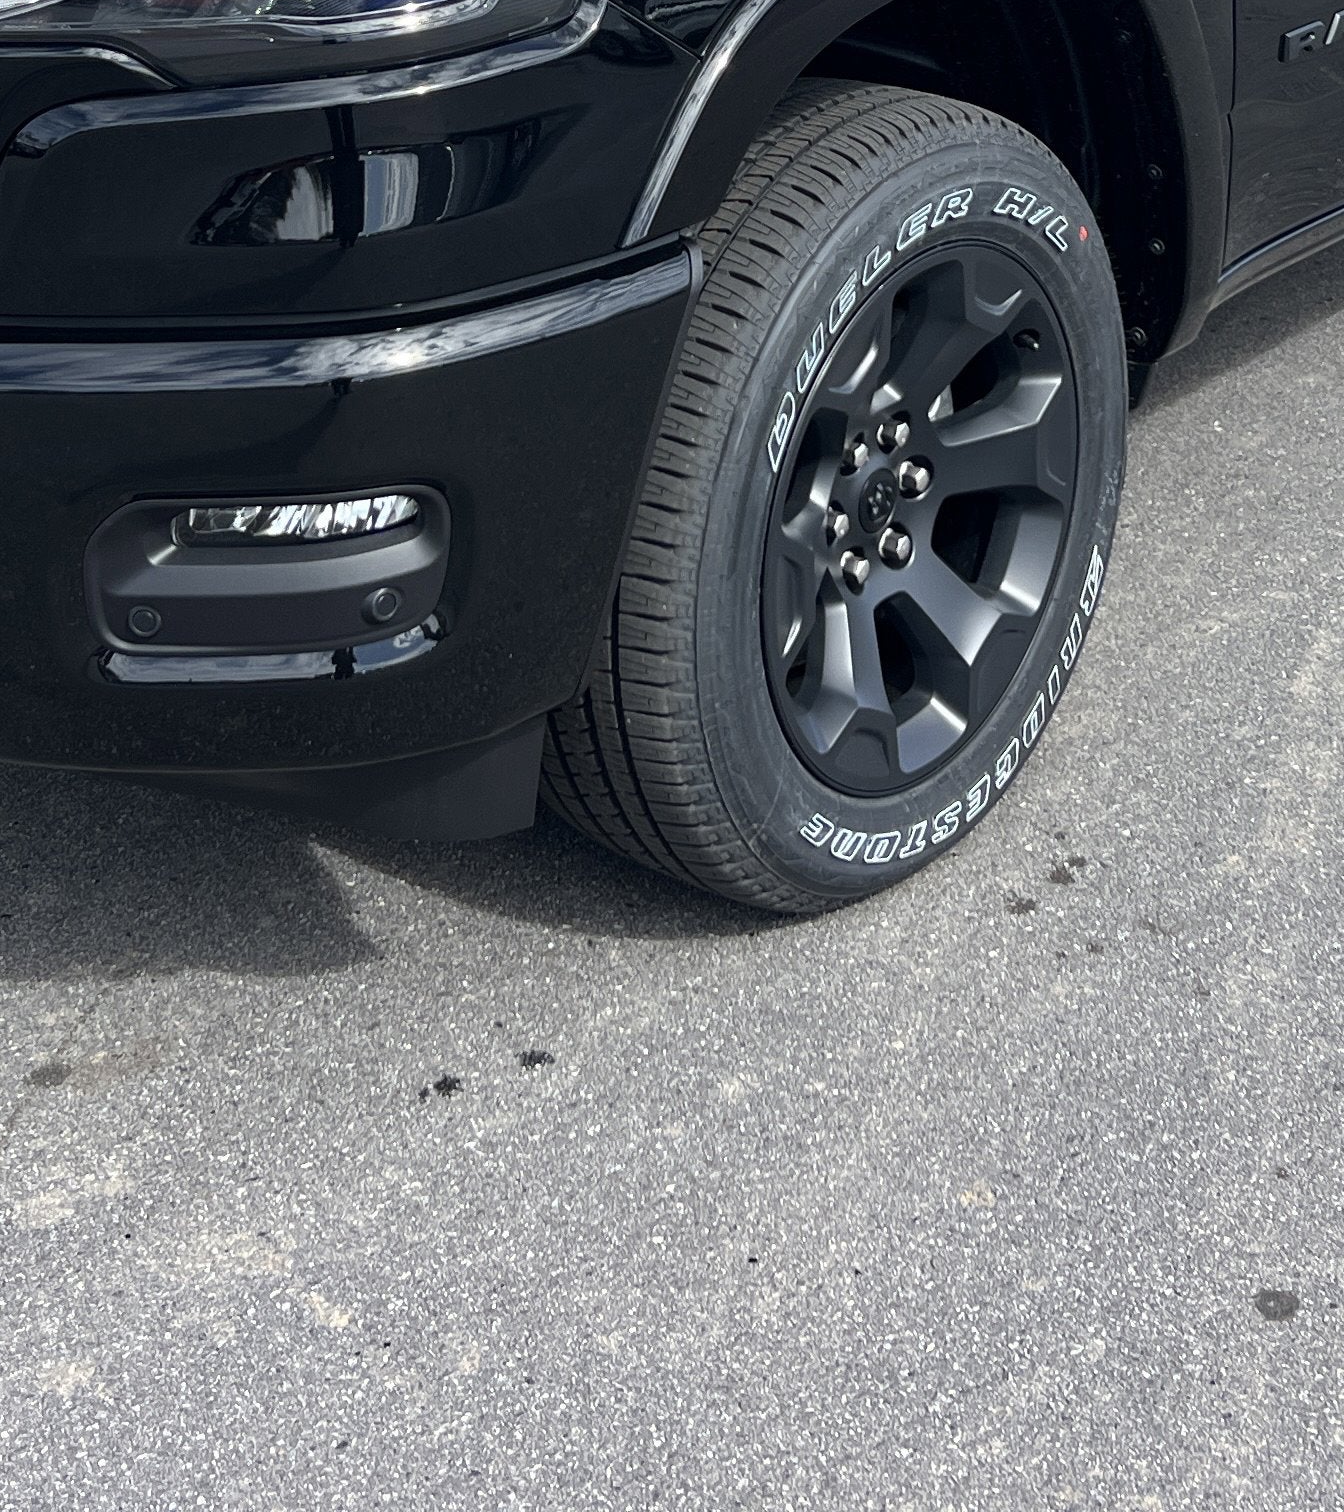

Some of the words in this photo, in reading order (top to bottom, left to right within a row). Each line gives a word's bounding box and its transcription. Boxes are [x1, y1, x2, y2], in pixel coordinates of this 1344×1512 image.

[766, 186, 974, 474] DUELER
[992, 186, 1072, 253] H/L
[799, 542, 1105, 865] BRIDGESTONE
